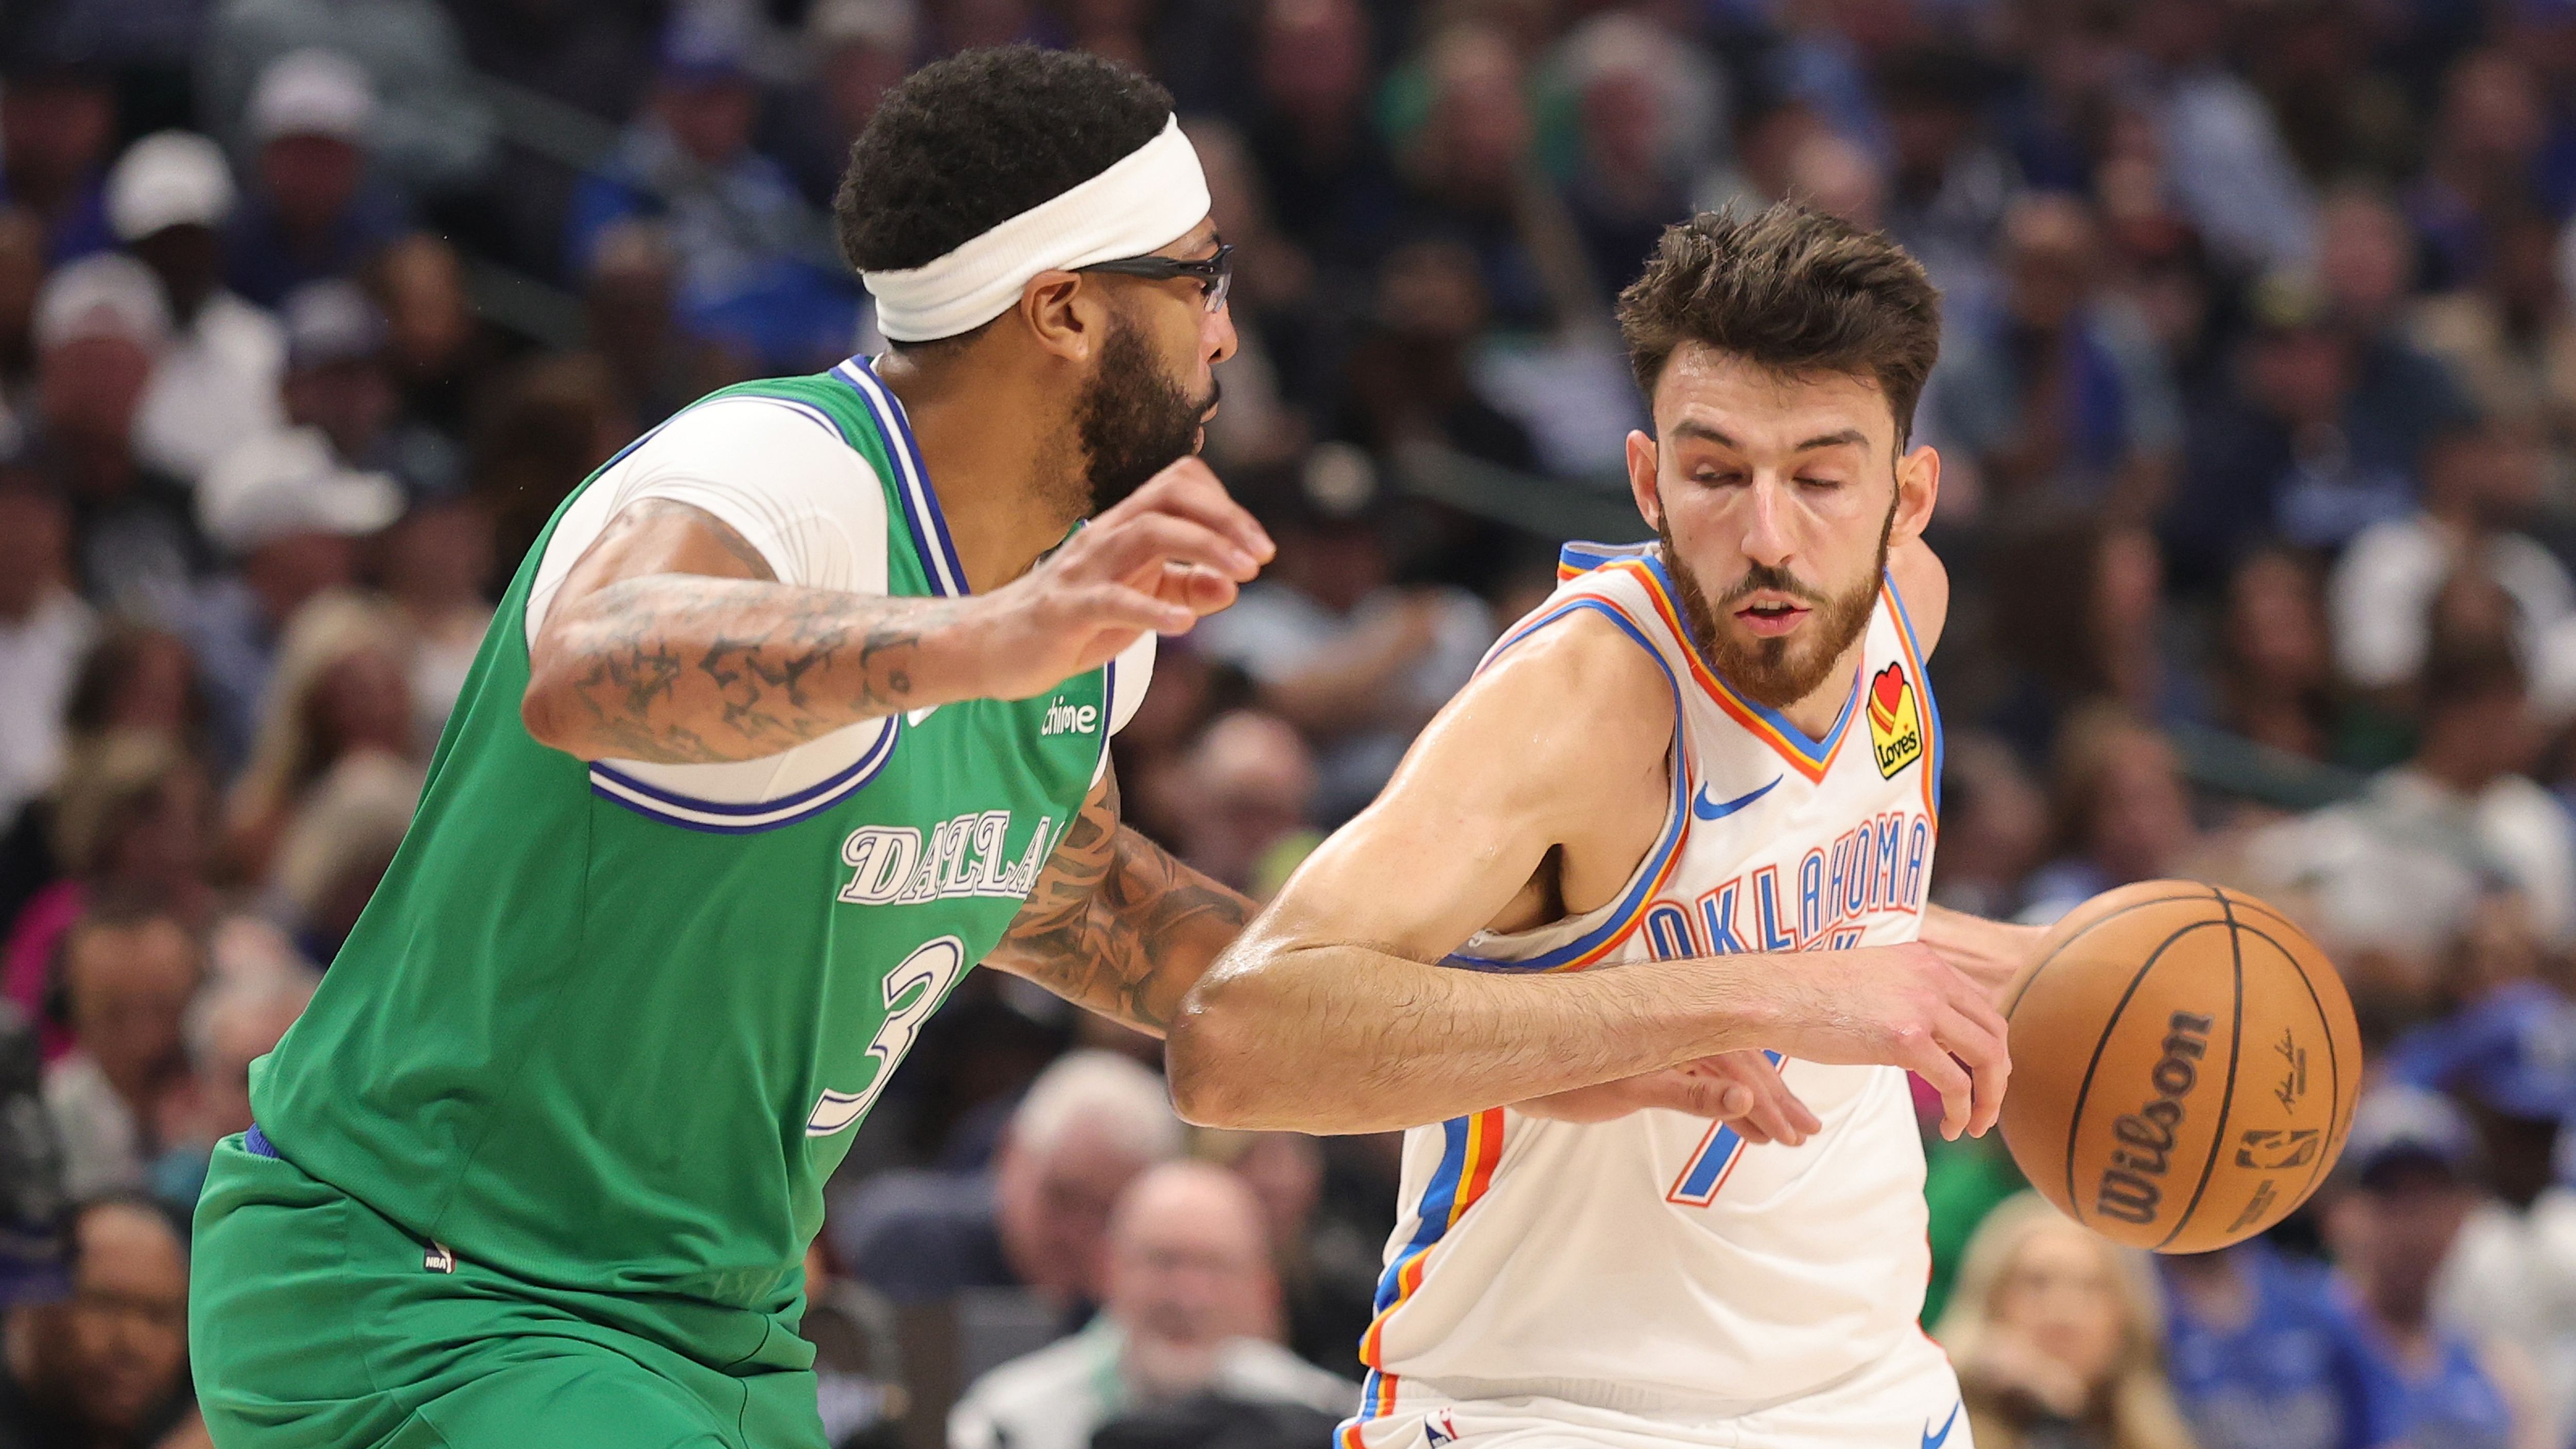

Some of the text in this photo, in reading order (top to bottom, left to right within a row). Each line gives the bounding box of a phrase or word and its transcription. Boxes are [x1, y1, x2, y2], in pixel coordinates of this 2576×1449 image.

[1041, 695, 1097, 736] chime
[838, 810, 1066, 906] DALLA
[1642, 811, 1929, 961] OKLAHOMA
[806, 934, 964, 1137] 3
[2097, 1010, 2215, 1225] Wilson
[425, 1256, 446, 1269] NBA
